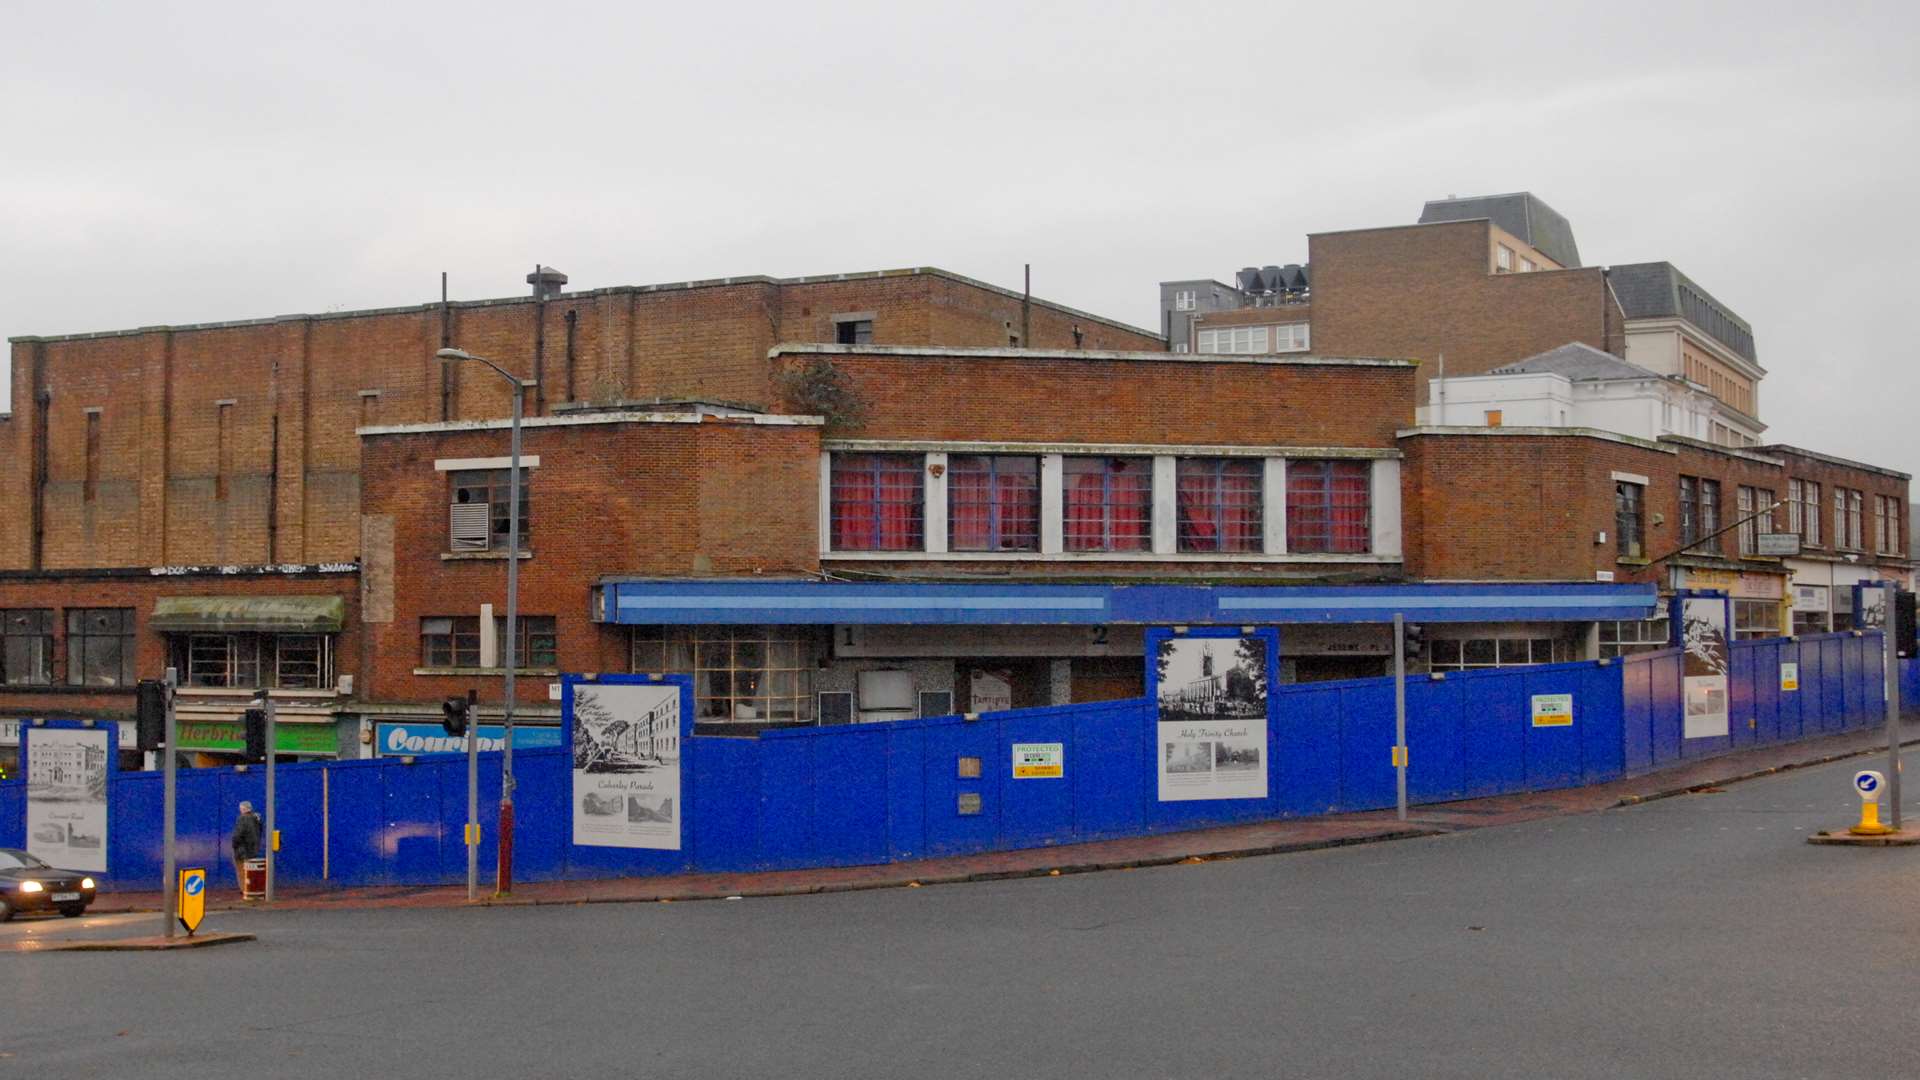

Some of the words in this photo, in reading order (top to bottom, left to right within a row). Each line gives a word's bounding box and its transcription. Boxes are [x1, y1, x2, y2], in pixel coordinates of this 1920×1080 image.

[843, 627, 855, 646] 1
[1092, 625, 1108, 645] 2
[1178, 728, 1196, 738] Holy
[1198, 727, 1222, 738] Trinity
[1224, 727, 1249, 737] Church
